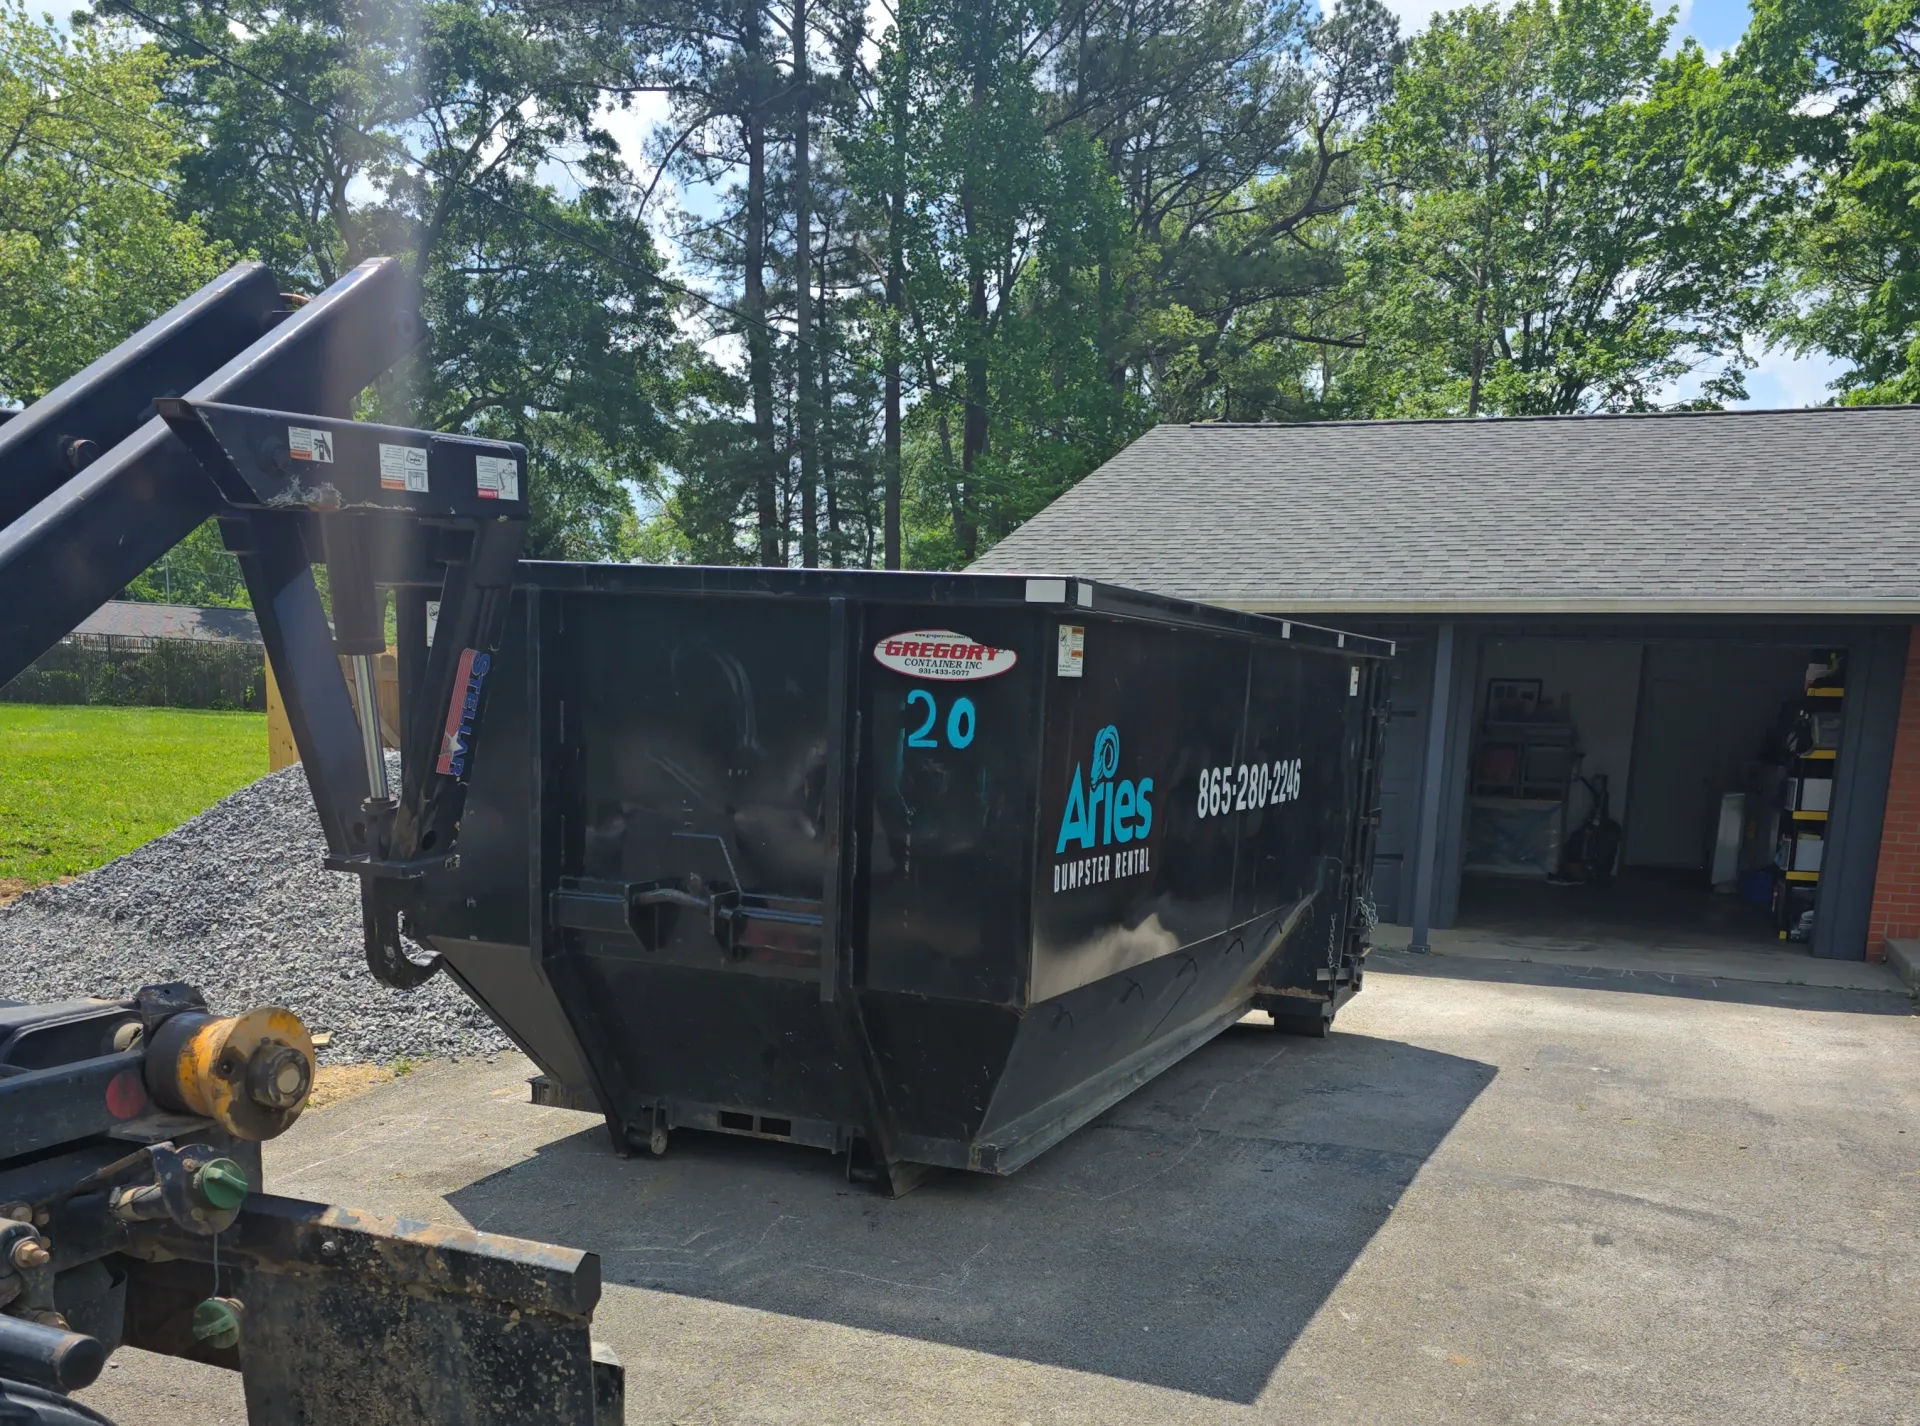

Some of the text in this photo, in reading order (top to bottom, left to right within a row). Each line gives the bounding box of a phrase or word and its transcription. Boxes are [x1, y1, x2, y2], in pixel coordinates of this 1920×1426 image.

[885, 640, 999, 661] GREGORY
[904, 658, 983, 670] CONTAINER INC
[918, 668, 969, 677] 931-433-5077
[449, 652, 490, 776] STELLAR
[908, 689, 976, 749] 20
[1055, 761, 1154, 854] Aries
[1197, 758, 1302, 819] 865-280-2246
[1053, 847, 1151, 893] DUMPSTER RENTAL
